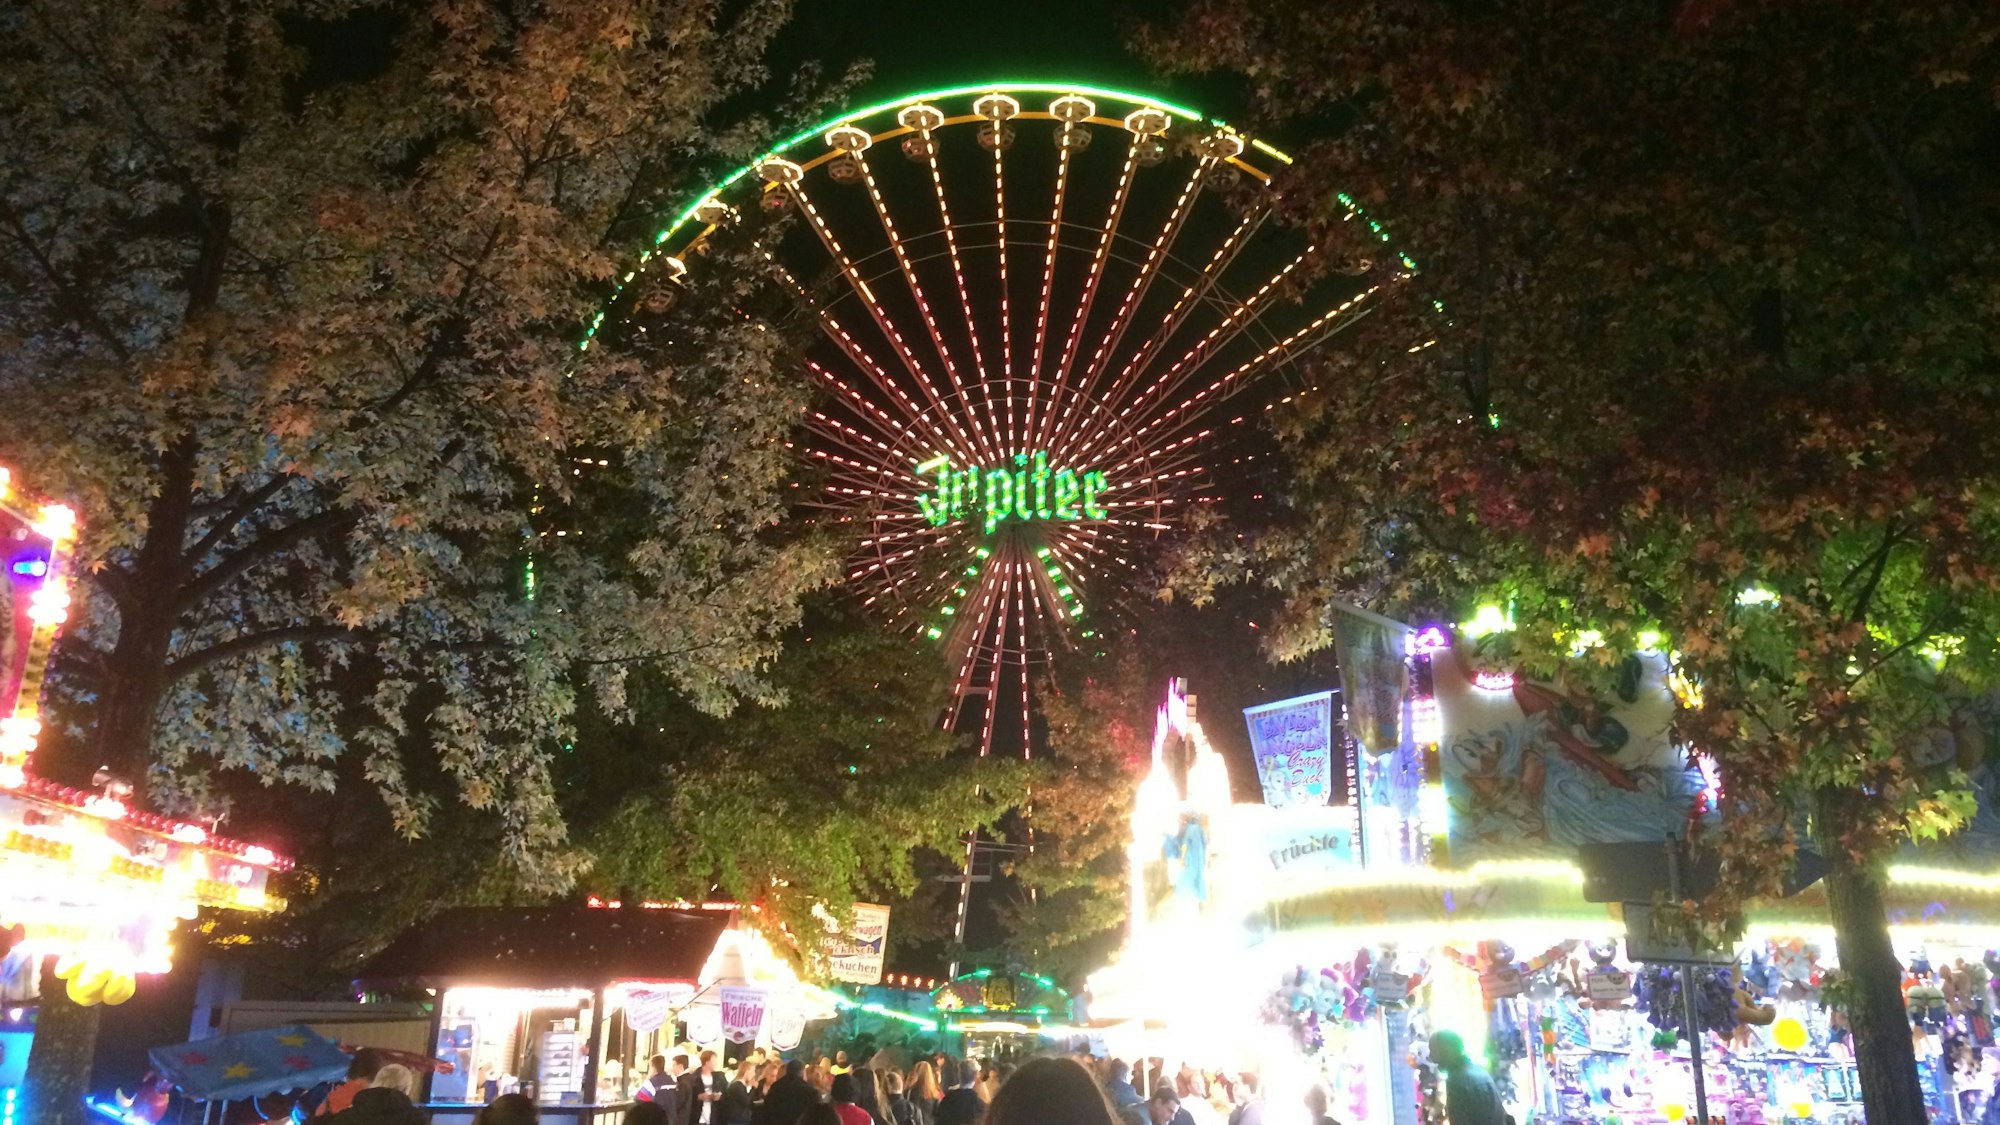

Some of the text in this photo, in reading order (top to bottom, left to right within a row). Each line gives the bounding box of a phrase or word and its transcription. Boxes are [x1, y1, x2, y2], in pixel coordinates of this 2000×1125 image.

[915, 449, 1108, 535] Jupiter
[1287, 750, 1325, 772] Crazy
[1292, 769, 1324, 786] Duck
[1268, 833, 1340, 870] Früchte
[832, 959, 878, 974] ekuchen
[725, 993, 762, 1002] FRISCHE
[722, 1001, 764, 1028] Waffeln
